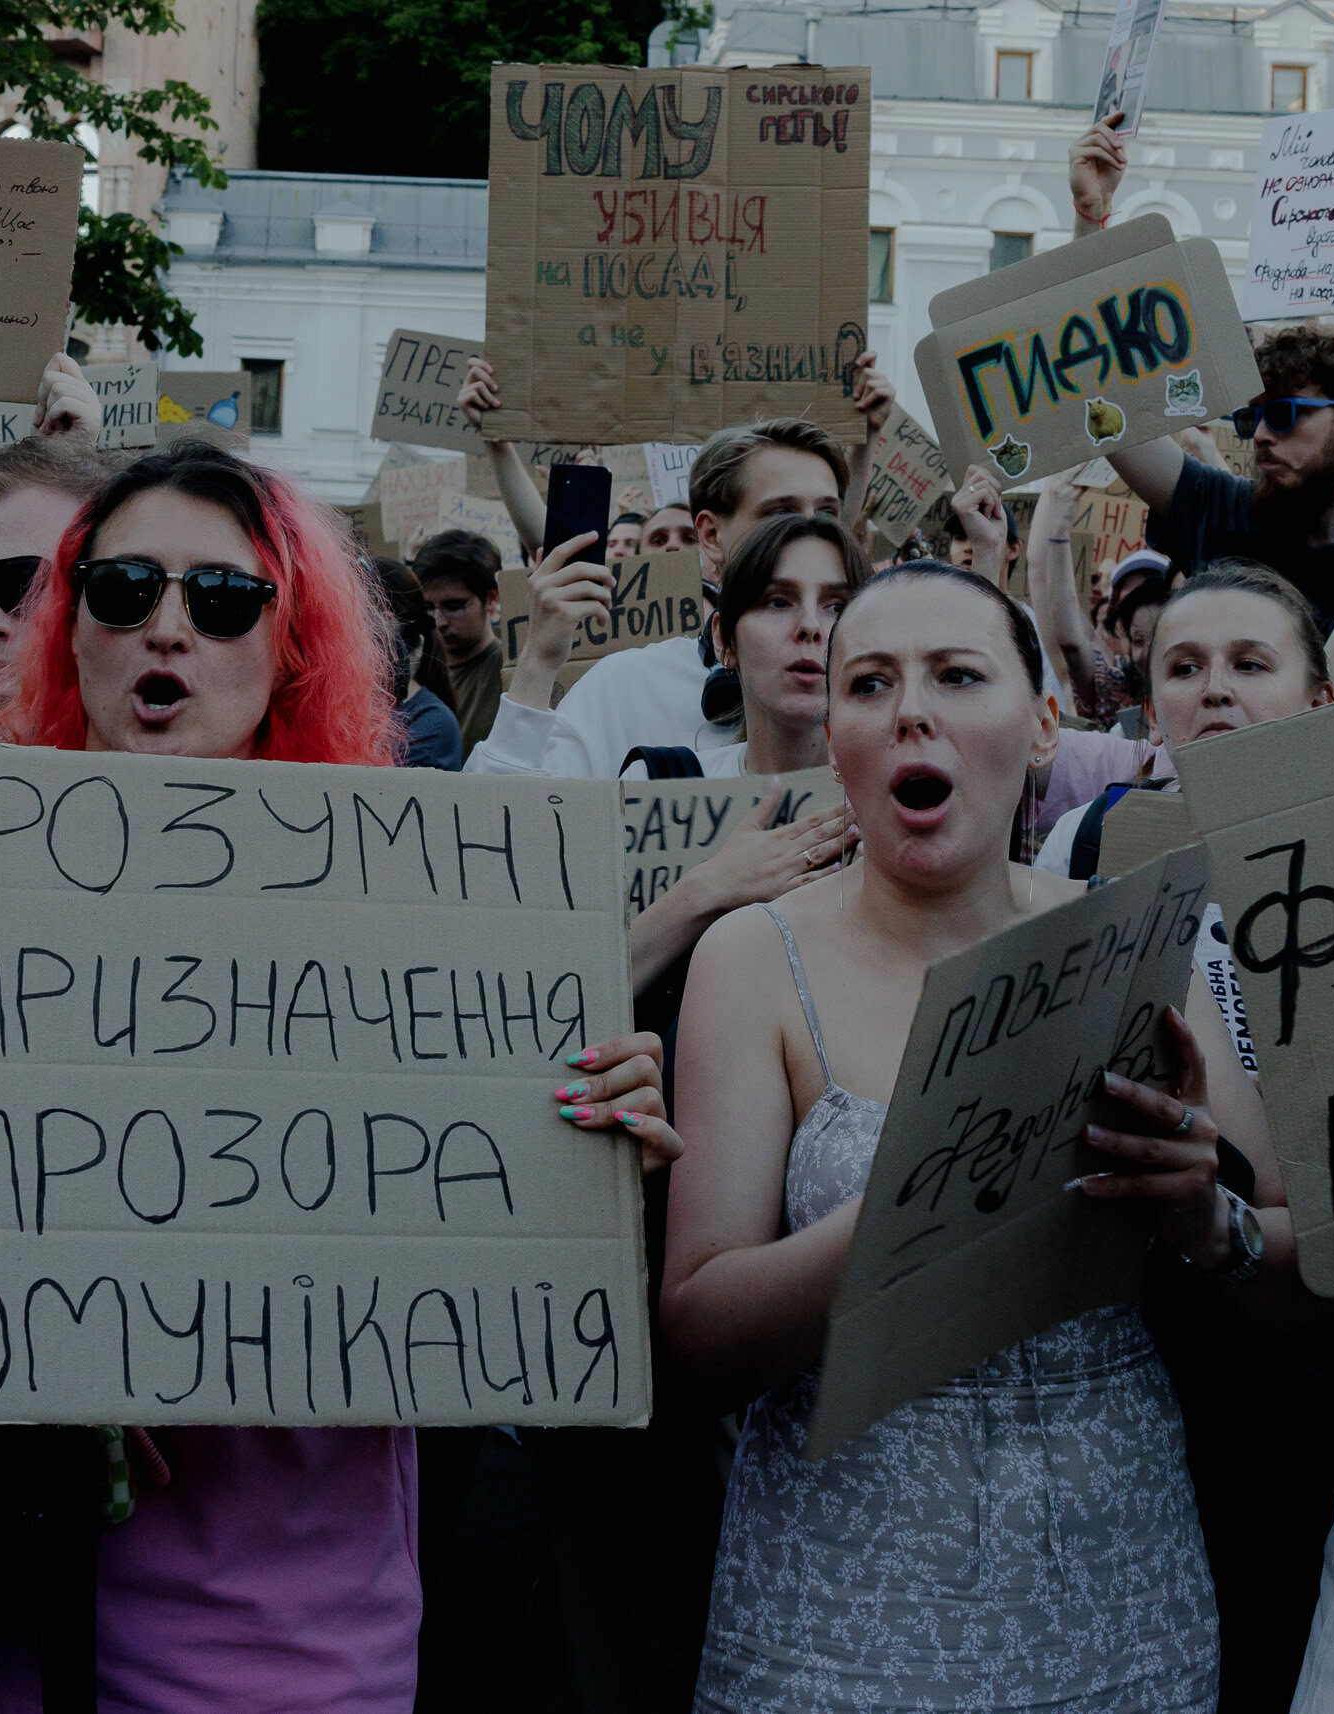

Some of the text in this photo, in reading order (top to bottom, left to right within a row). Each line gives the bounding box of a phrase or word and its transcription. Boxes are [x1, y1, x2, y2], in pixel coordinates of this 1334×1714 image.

[507, 81, 722, 179] ЧОМУ
[747, 83, 858, 105] СИРСЬКОГО
[760, 108, 849, 152] ГЕТЬ!
[595, 190, 768, 254] УБИВЦЯ
[957, 284, 1193, 442] ГИДКО
[921, 883, 1206, 1095] ПОВЕРНІТЬ
